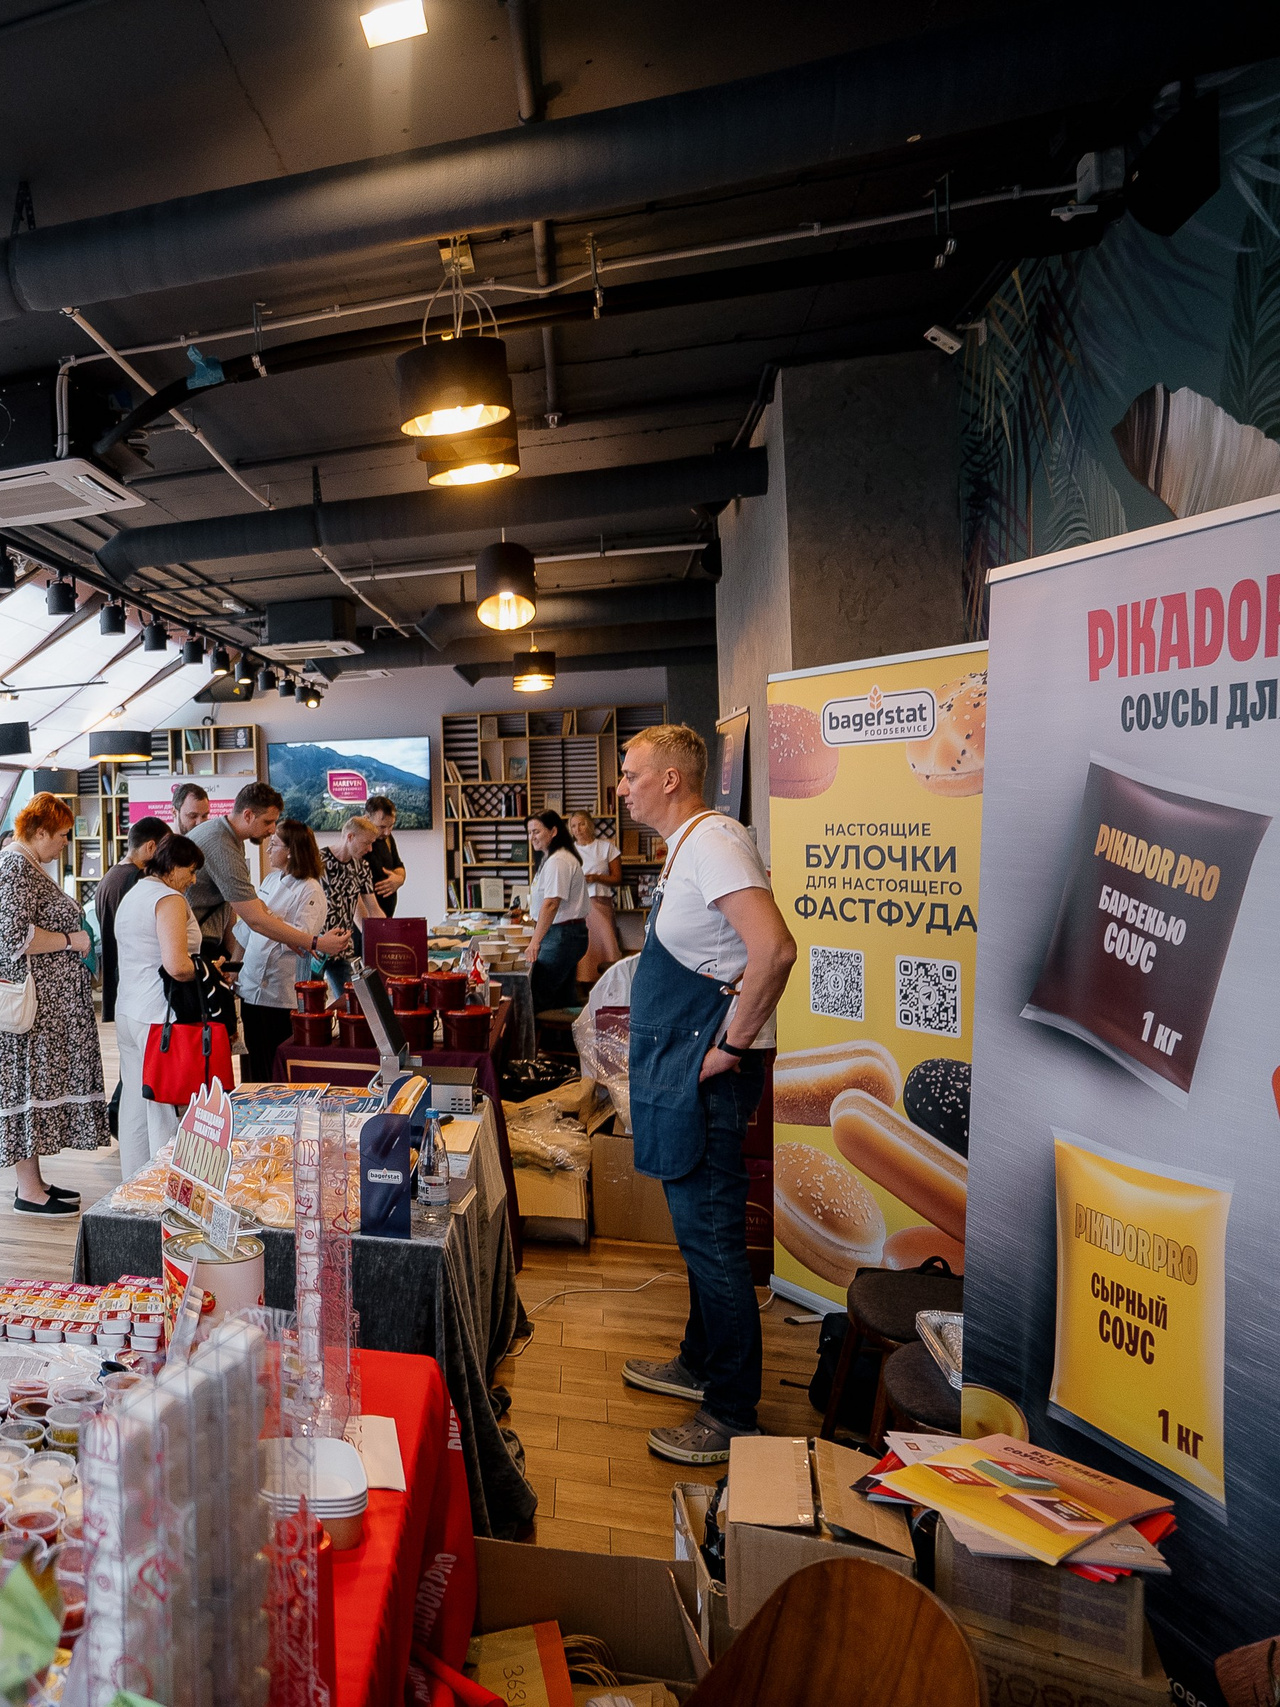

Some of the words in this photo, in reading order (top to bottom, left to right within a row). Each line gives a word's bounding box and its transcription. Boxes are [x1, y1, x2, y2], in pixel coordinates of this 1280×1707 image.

[828, 703, 927, 733] bagerstat
[1121, 685, 1219, 733] СОУСЫ
[1225, 678, 1280, 730] ДЛ
[864, 724, 928, 738] FOODSERVICE
[825, 823, 931, 839] НАСТОЯЩИЕ
[805, 844, 957, 874] БУЛОЧКИ
[1094, 823, 1175, 886] PIKADOR
[1171, 854, 1220, 902] PRO
[806, 876, 837, 891] ДЛЯ
[842, 877, 962, 896] НАСТОЯЩЕГО
[794, 894, 978, 937] ФАСТФУДА
[1098, 884, 1187, 946] БАРБЕКЬЮ
[1104, 922, 1157, 974] СОУС
[1141, 1010, 1156, 1042] 1
[174, 1127, 230, 1192] PIKADOR
[1075, 1203, 1153, 1269] PIKADOR
[1152, 1233, 1199, 1286] PRO
[1091, 1272, 1168, 1332] СЫРНЫЙ
[1098, 1309, 1155, 1365] СОУС
[1157, 1408, 1170, 1444] 1
[424, 1553, 458, 1586] PRO
